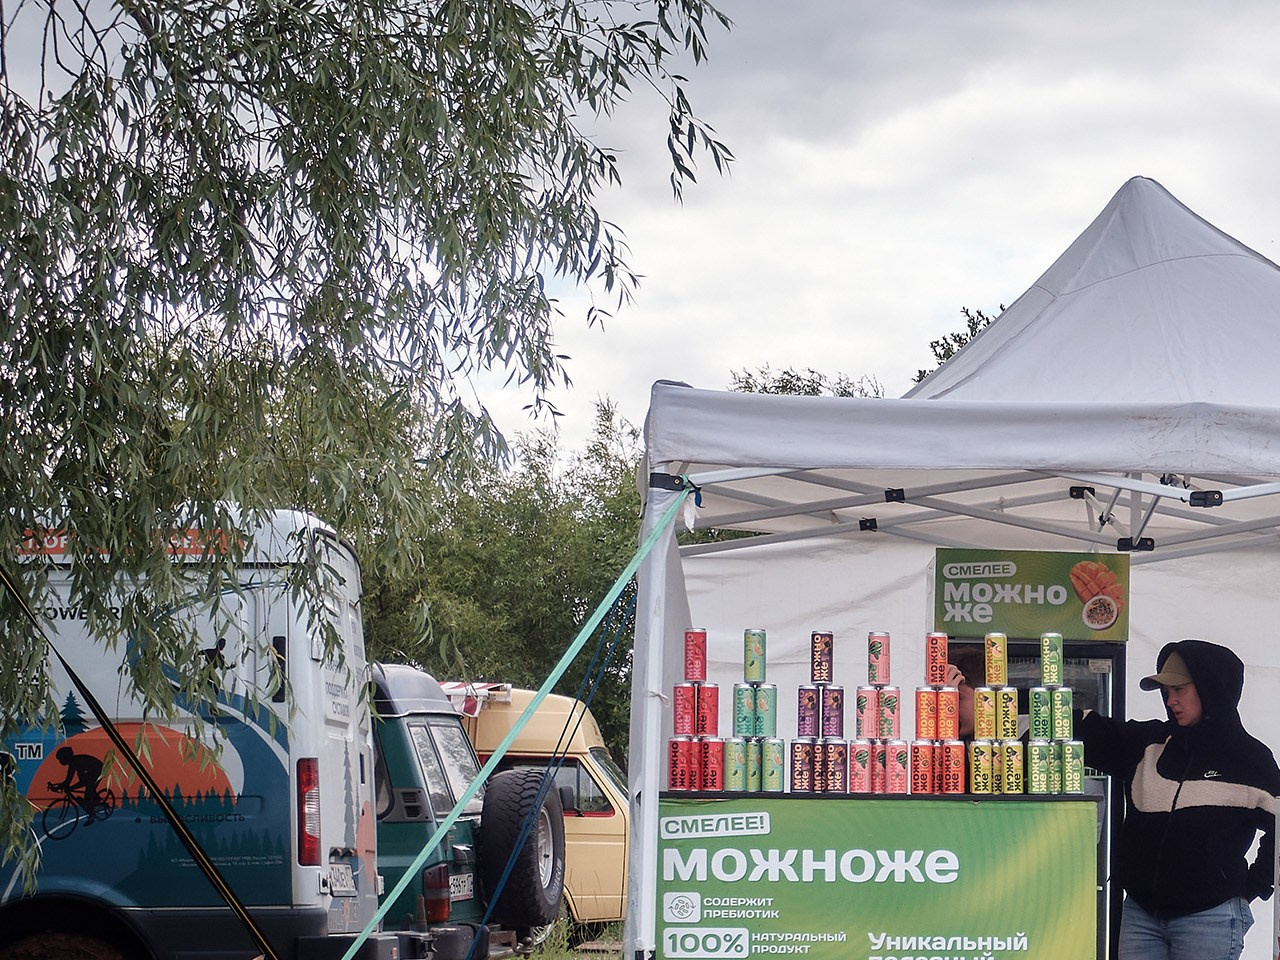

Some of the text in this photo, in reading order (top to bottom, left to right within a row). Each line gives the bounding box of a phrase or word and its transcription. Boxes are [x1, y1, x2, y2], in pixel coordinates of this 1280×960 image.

[948, 564, 1011, 576] СМЕЛЕЕ
[150, 813, 246, 824] ВЫСЛИВОСТЬ
[665, 816, 765, 834] СМЕЛЕЕ!
[704, 898, 774, 907] СОДЕРЖИТ
[704, 910, 779, 919] ПРЕБИОТИК
[752, 931, 847, 942] НАТУРАЛЬНЫЙ
[868, 932, 1028, 952] Уникальный
[668, 933, 745, 953] 100%
[752, 945, 811, 954] ПРОДУКТ
